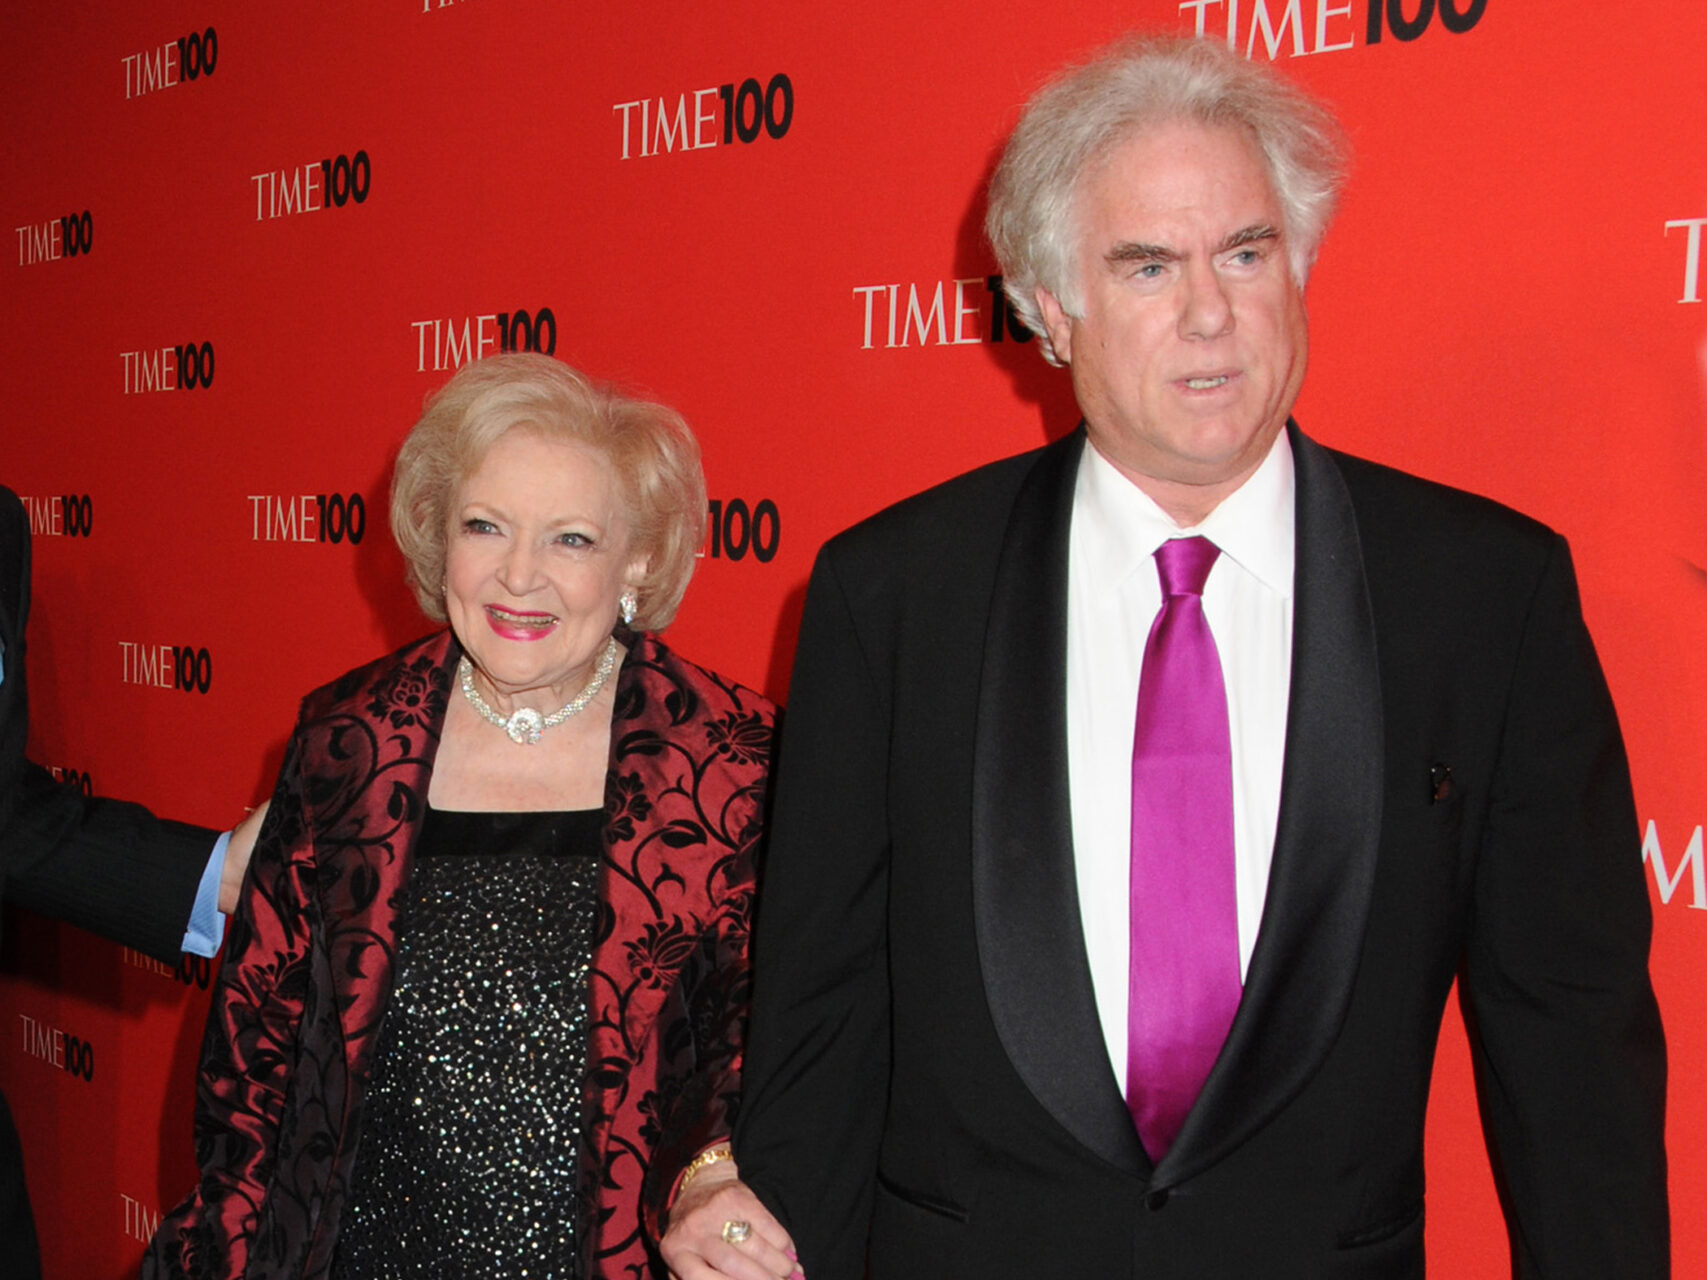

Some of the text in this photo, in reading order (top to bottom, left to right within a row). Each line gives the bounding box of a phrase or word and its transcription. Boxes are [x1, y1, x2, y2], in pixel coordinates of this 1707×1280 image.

[121, 27, 218, 99] TIME100
[613, 73, 794, 160] TIME100
[251, 150, 371, 221] TIME100
[16, 210, 93, 266] TIME100
[120, 341, 215, 394] TIME100
[411, 307, 557, 372] TIME100
[248, 493, 366, 545] TIME100
[695, 498, 781, 563] 100
[119, 641, 212, 694] TIME100
[20, 1014, 94, 1082] TIME100
